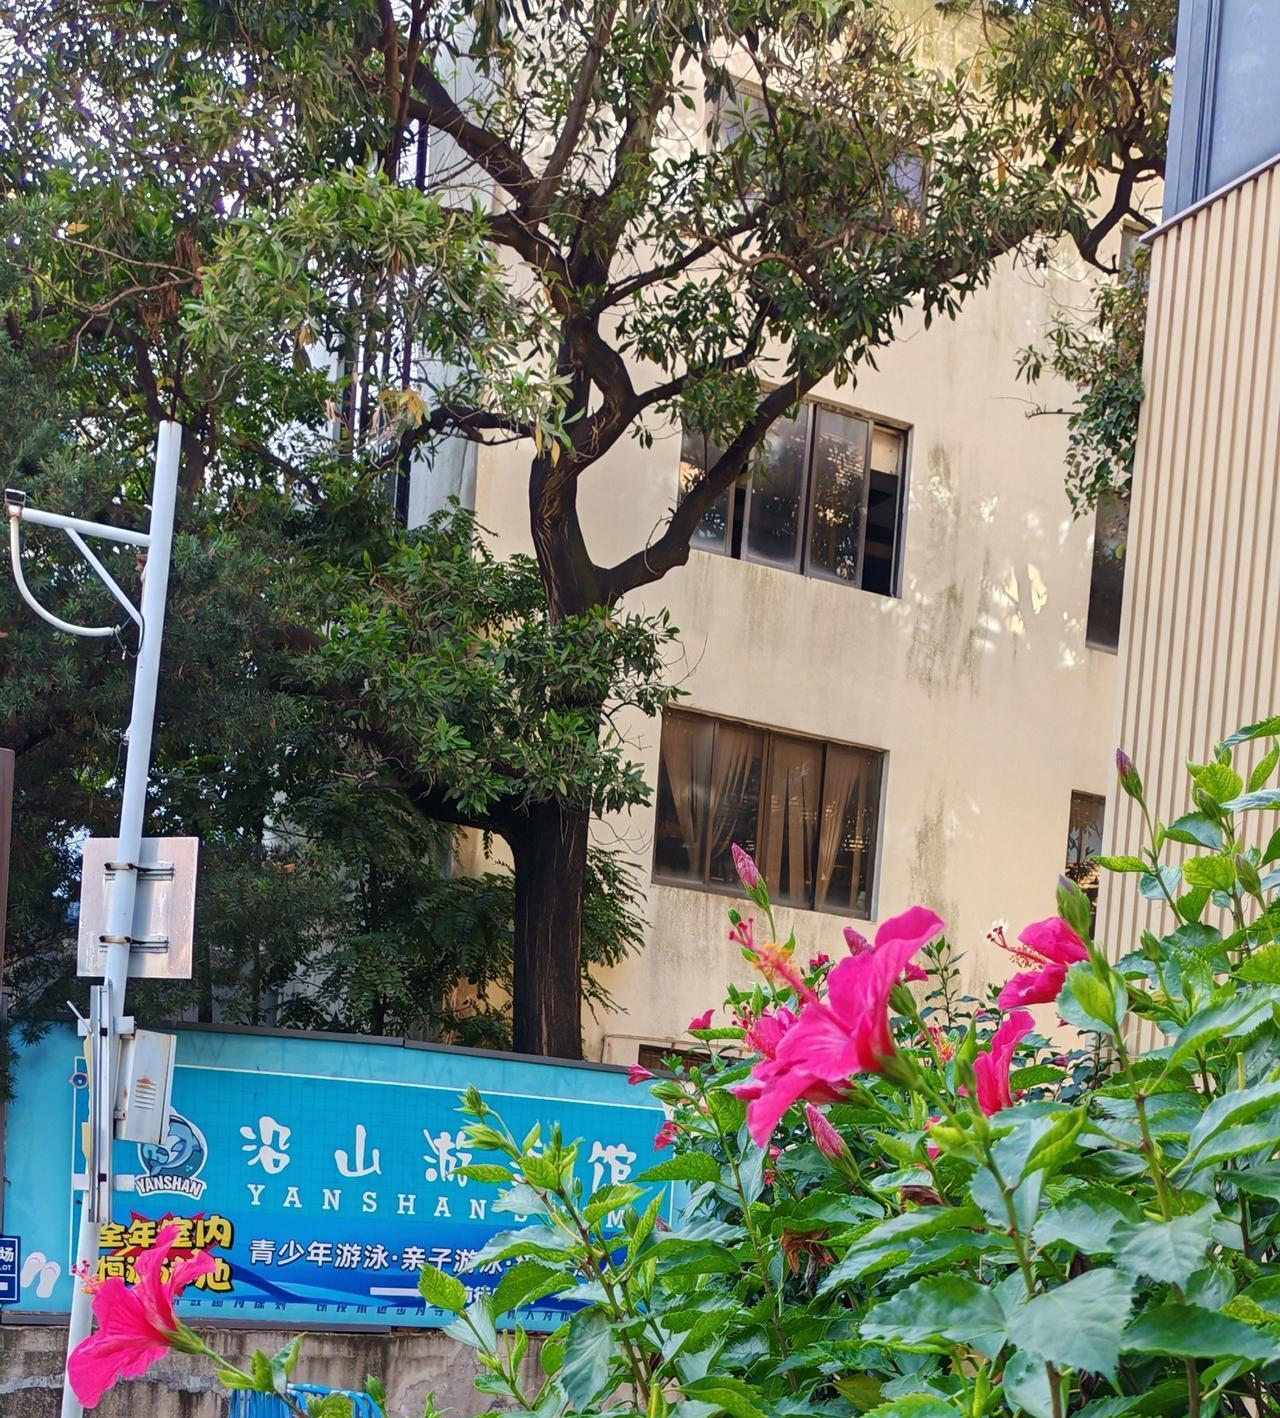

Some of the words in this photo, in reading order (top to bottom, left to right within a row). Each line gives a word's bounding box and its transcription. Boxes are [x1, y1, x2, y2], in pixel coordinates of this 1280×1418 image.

[136, 1175, 202, 1197] YANSHAN
[247, 1183, 487, 1220] YANSHAN
[98, 1214, 234, 1249] 全年室内
[97, 1255, 233, 1291] 恒池
